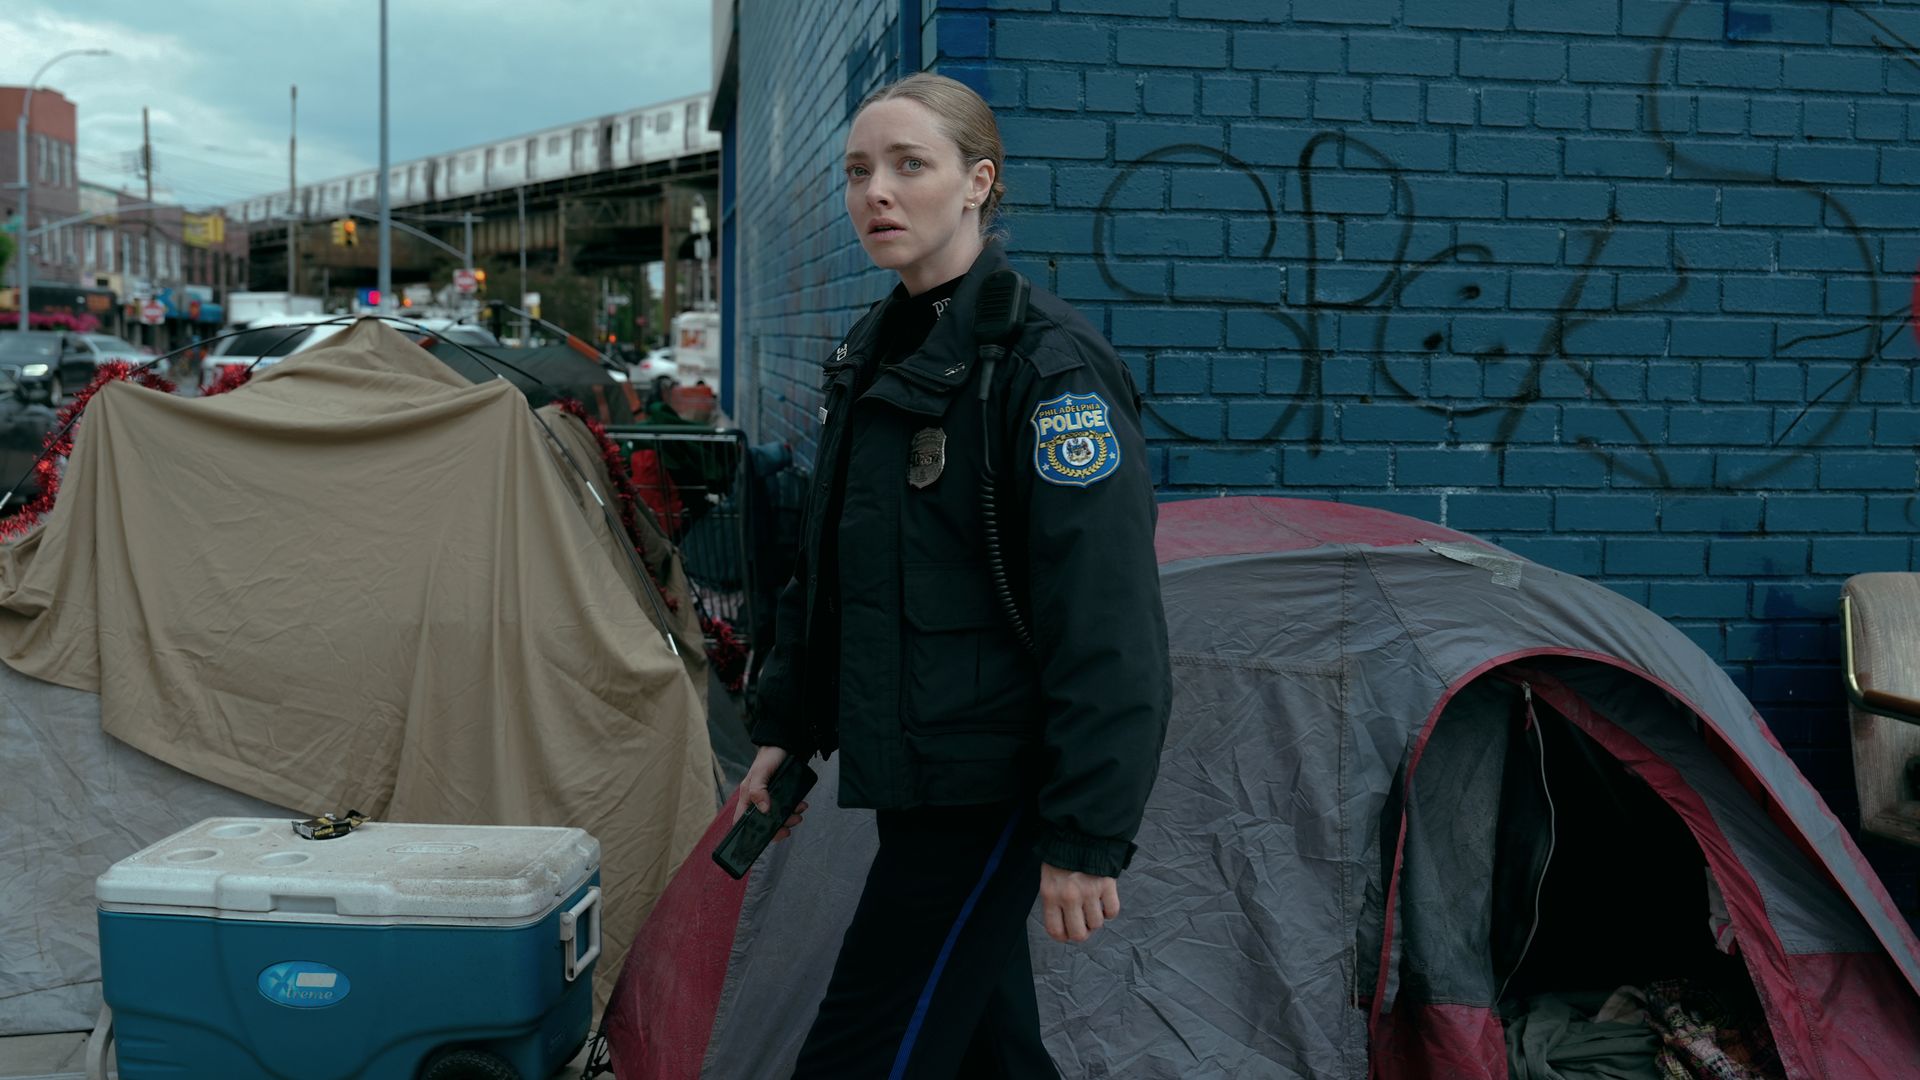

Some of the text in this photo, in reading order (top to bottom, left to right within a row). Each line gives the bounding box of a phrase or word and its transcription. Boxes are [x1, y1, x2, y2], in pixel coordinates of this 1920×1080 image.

[1039, 403, 1100, 417] PHILADELPHIA
[1039, 410, 1105, 435] POLICE
[266, 962, 333, 1000] Xtreme
